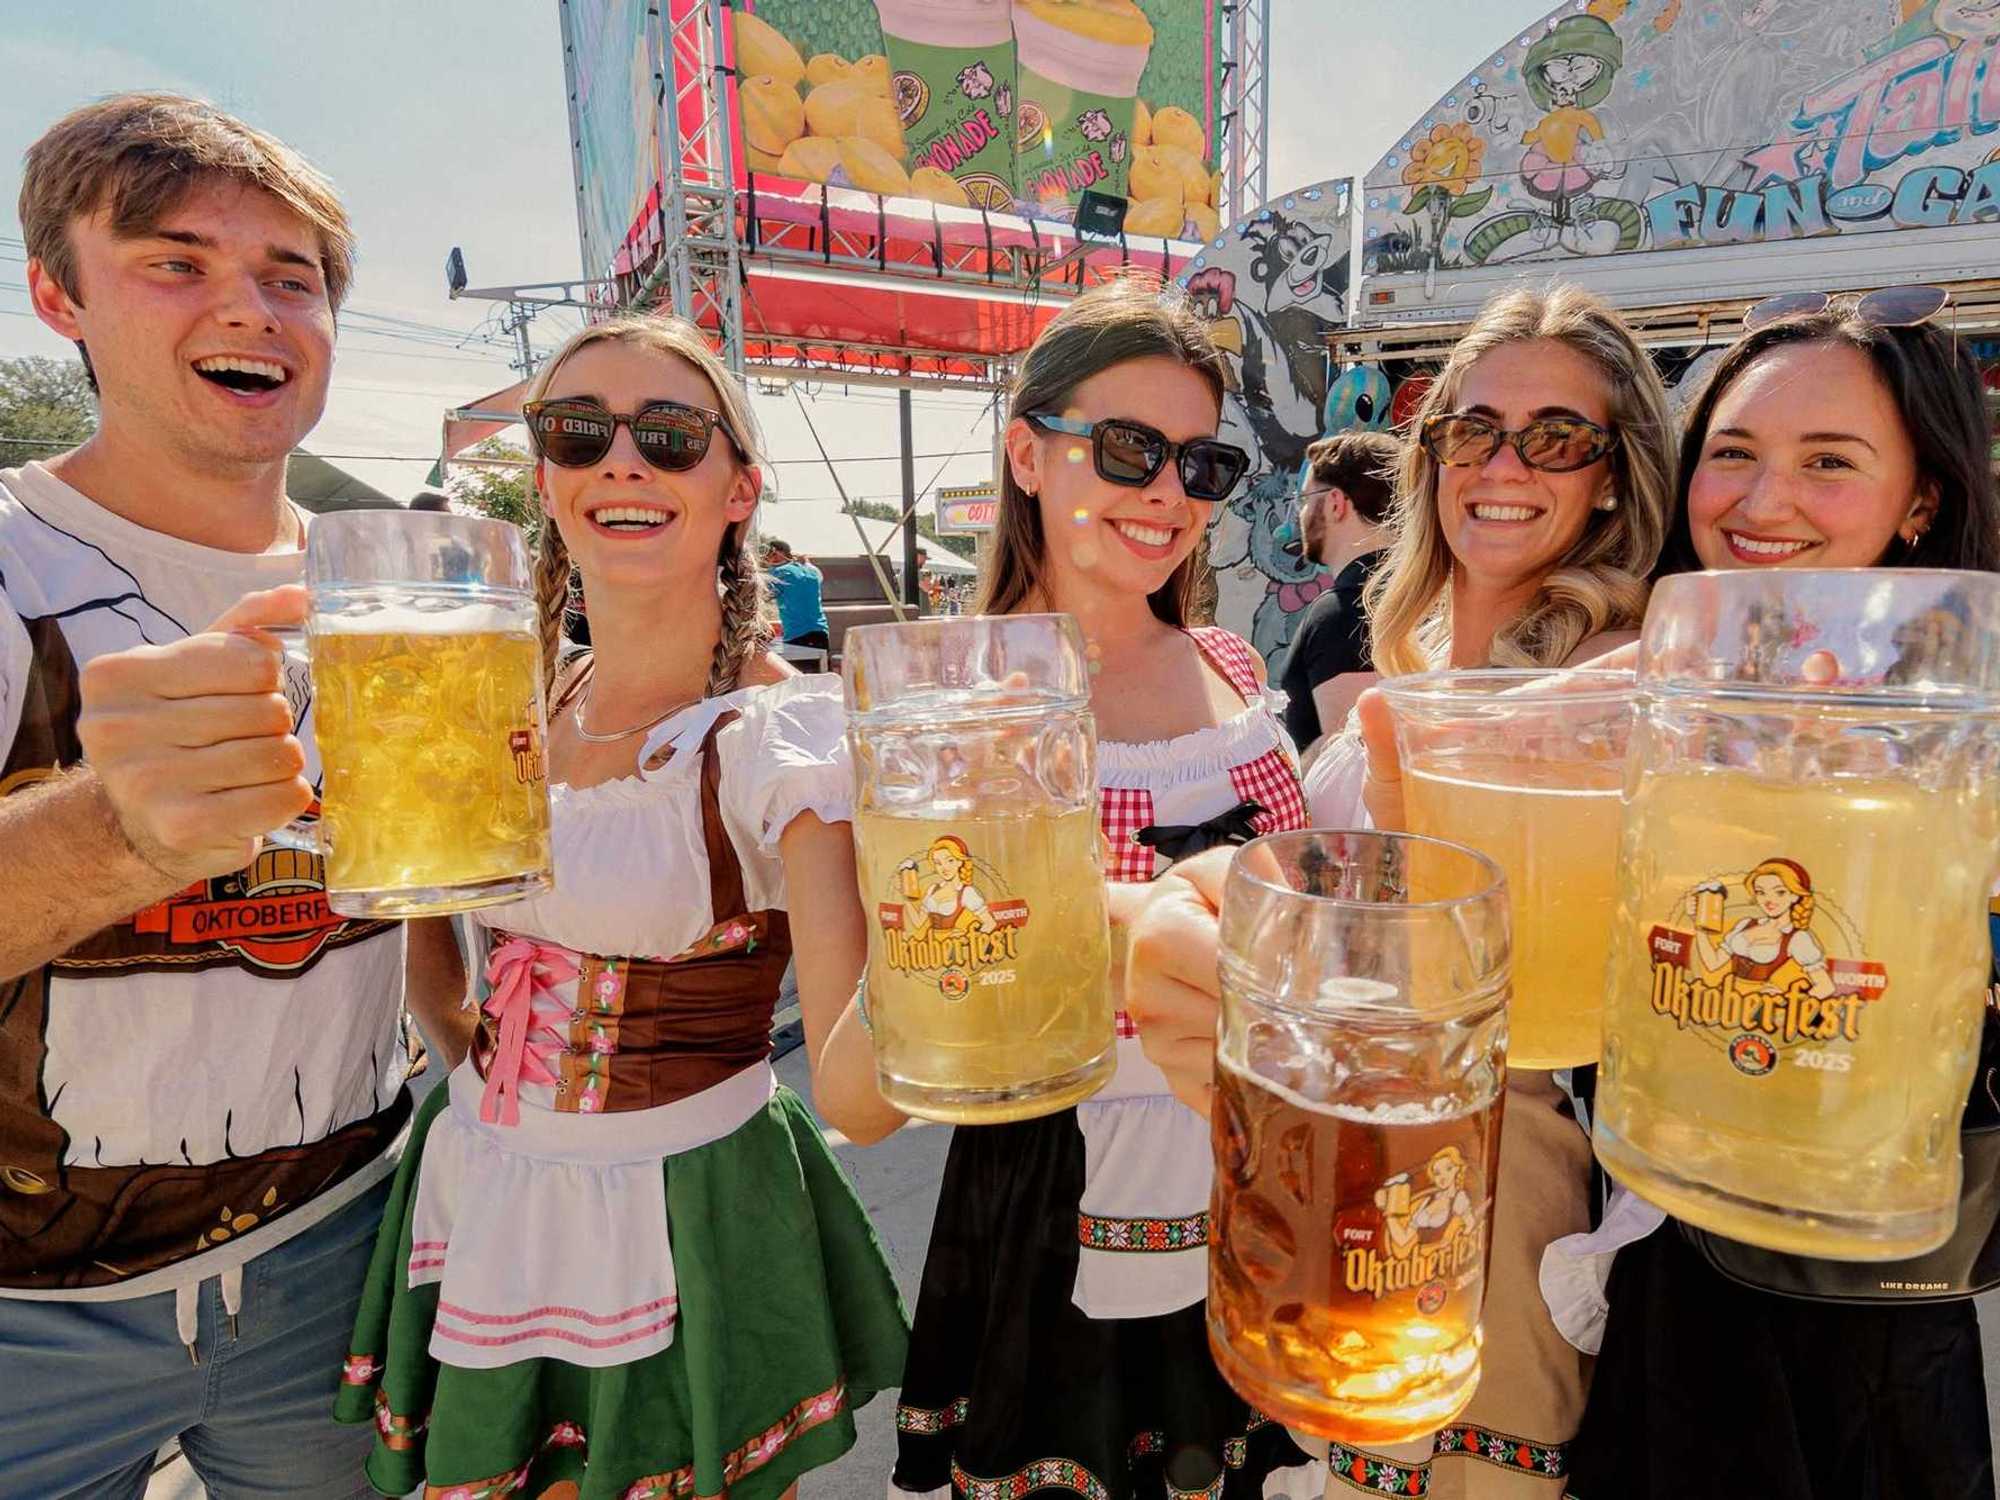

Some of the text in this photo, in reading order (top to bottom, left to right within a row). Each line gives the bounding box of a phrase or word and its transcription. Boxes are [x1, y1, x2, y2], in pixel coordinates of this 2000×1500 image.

[1646, 174, 1834, 246] FUN
[884, 921, 1019, 978] Oktoberfest
[1654, 938, 1682, 954] FORT
[980, 970, 1017, 986] 2025
[1651, 961, 1866, 1043] Oktoberfest
[1793, 1048, 1852, 1072] 2025
[1343, 1227, 1374, 1241] FORT
[1880, 1281, 1903, 1290] LIKE
